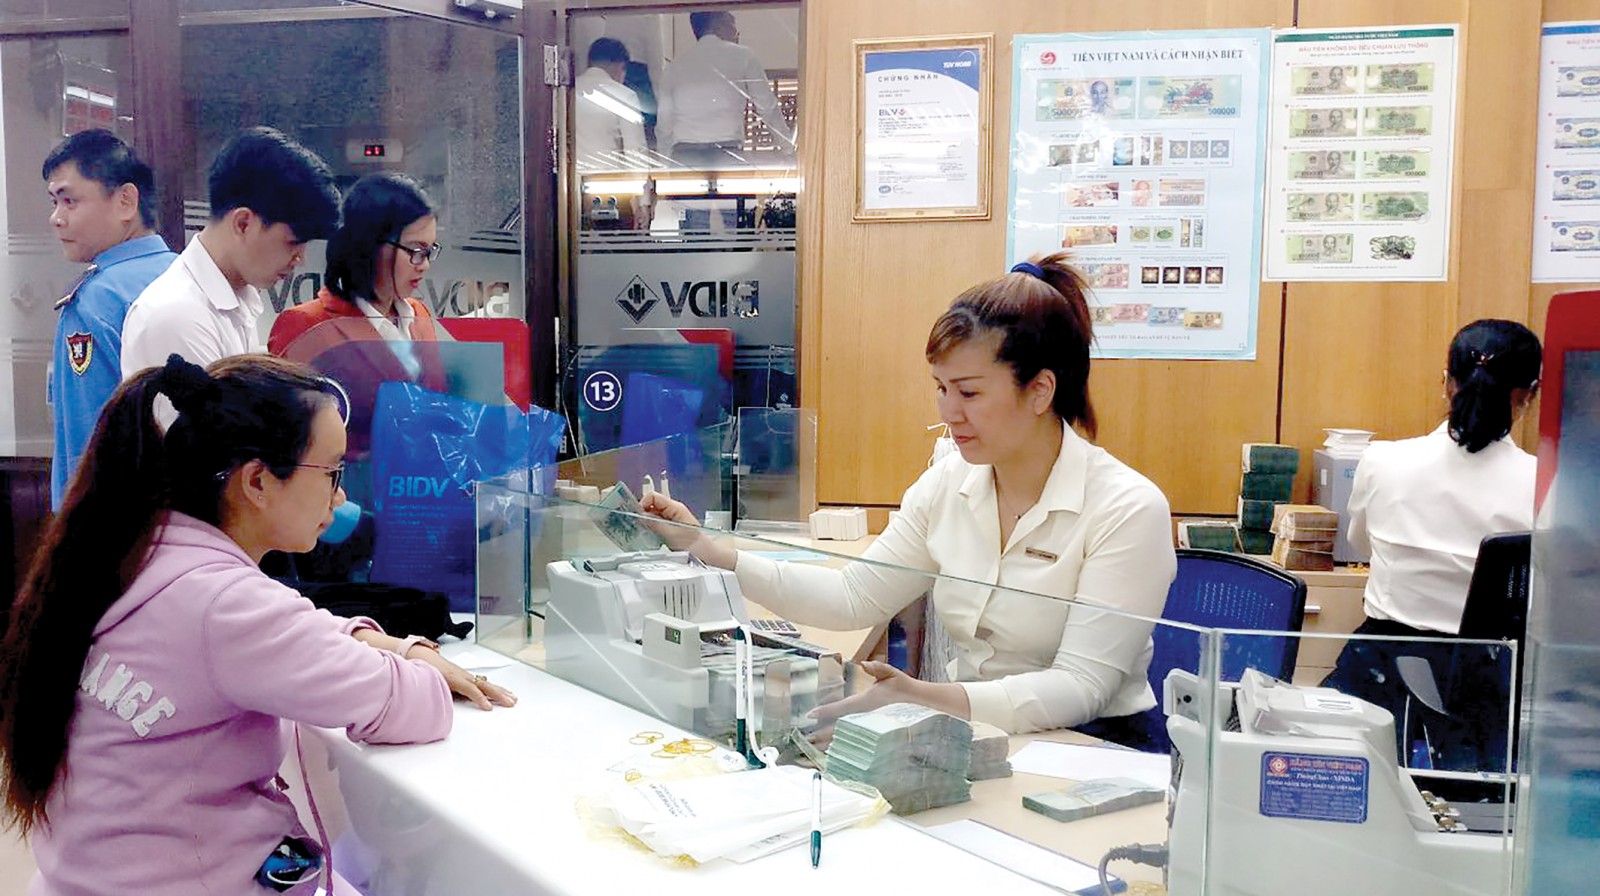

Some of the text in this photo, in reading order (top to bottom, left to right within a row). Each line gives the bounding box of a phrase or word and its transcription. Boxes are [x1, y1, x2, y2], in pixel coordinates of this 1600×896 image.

[1097, 51, 1120, 63] VIỆT
[1121, 51, 1144, 61] NAM
[1146, 49, 1158, 60] VÀ
[1160, 48, 1188, 60] CÁCH
[1191, 48, 1218, 61] NHẬN
[590, 381, 615, 401] 13
[389, 476, 451, 498] BIDV
